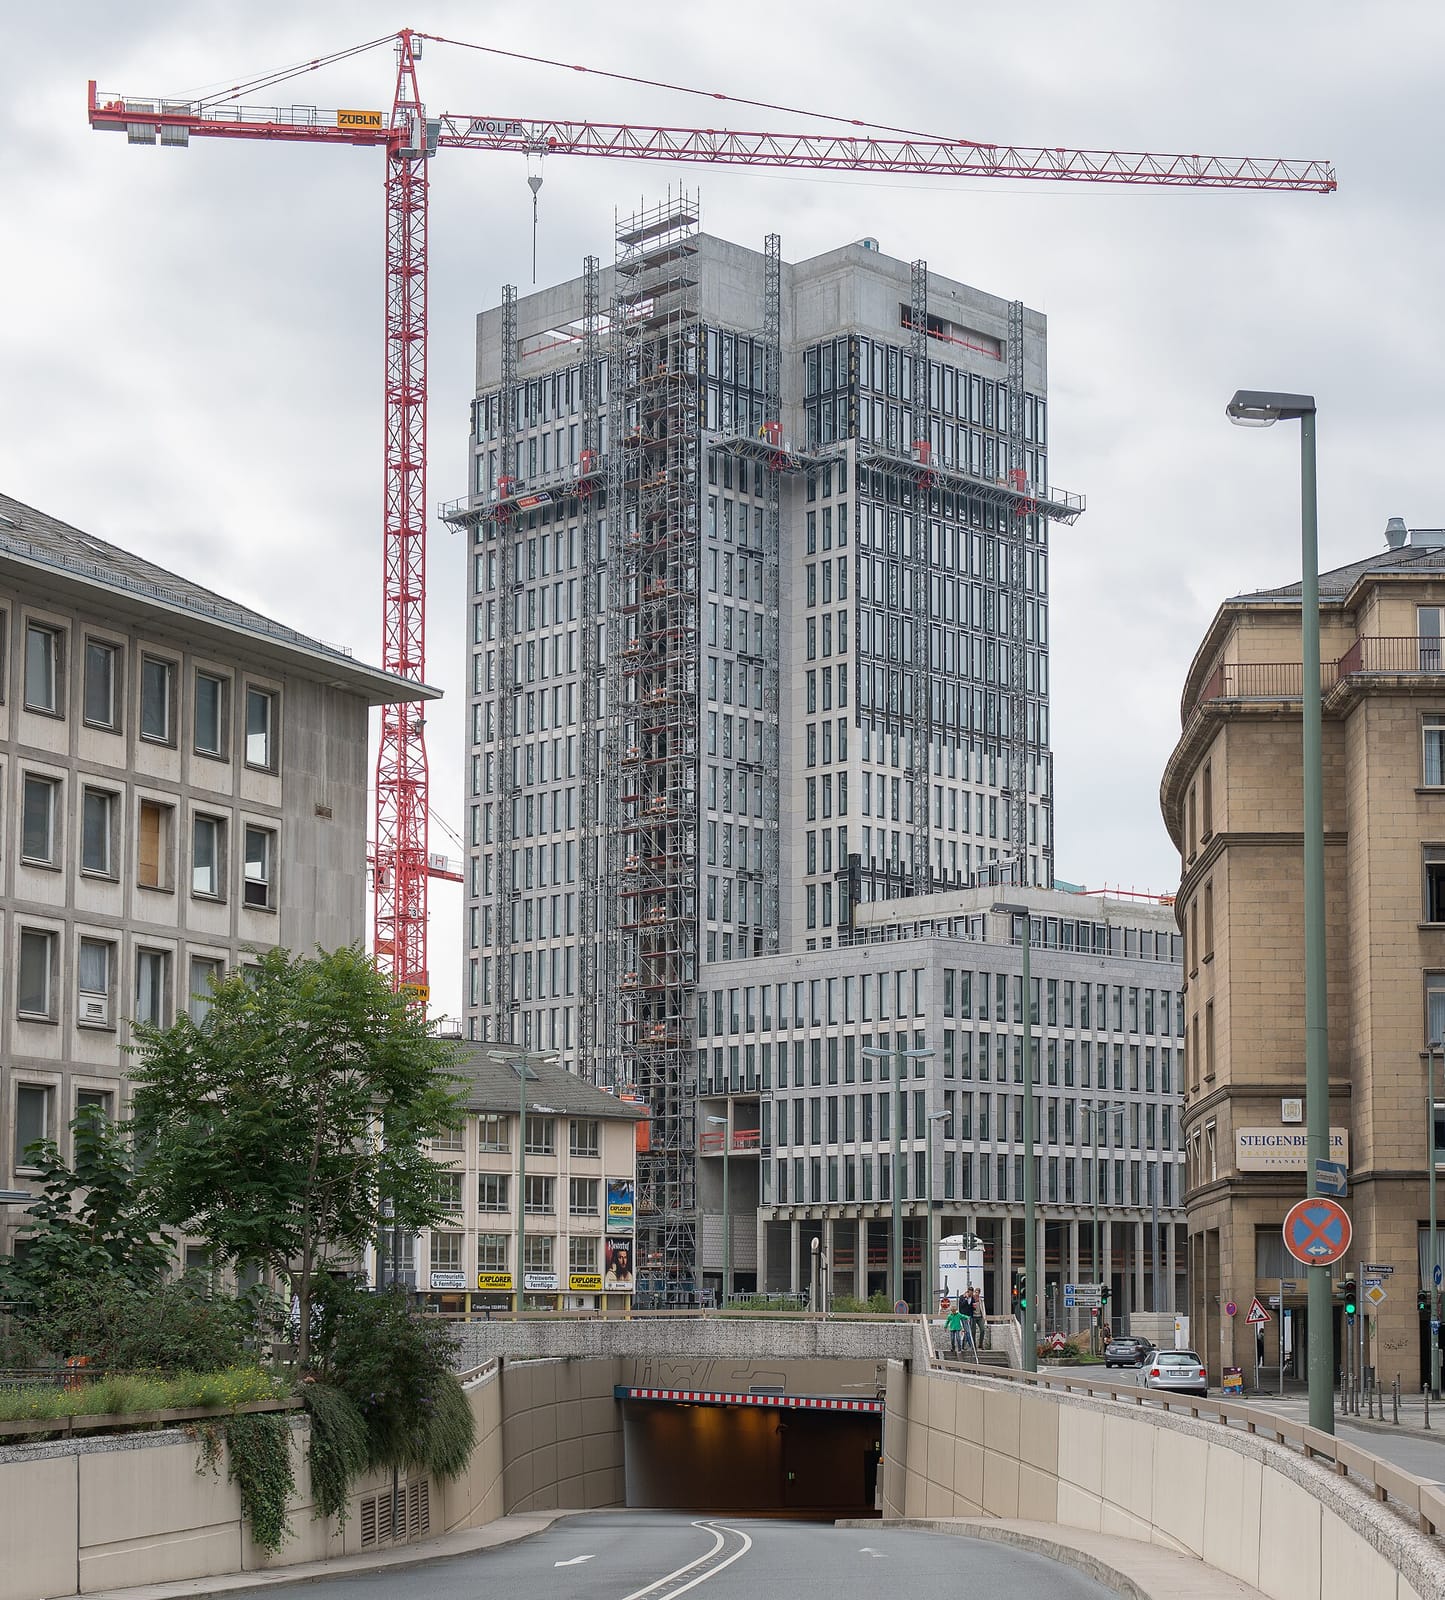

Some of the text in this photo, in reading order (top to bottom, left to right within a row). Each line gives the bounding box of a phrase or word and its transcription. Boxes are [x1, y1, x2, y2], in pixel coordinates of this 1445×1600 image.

[339, 113, 381, 126] ZÜBLIN
[474, 120, 521, 134] WOLFF
[412, 909, 417, 917] 3
[1240, 1135, 1344, 1146] STEIGENBEER
[479, 1275, 512, 1283] EXPLORER
[571, 1276, 602, 1284] EXPLORER
